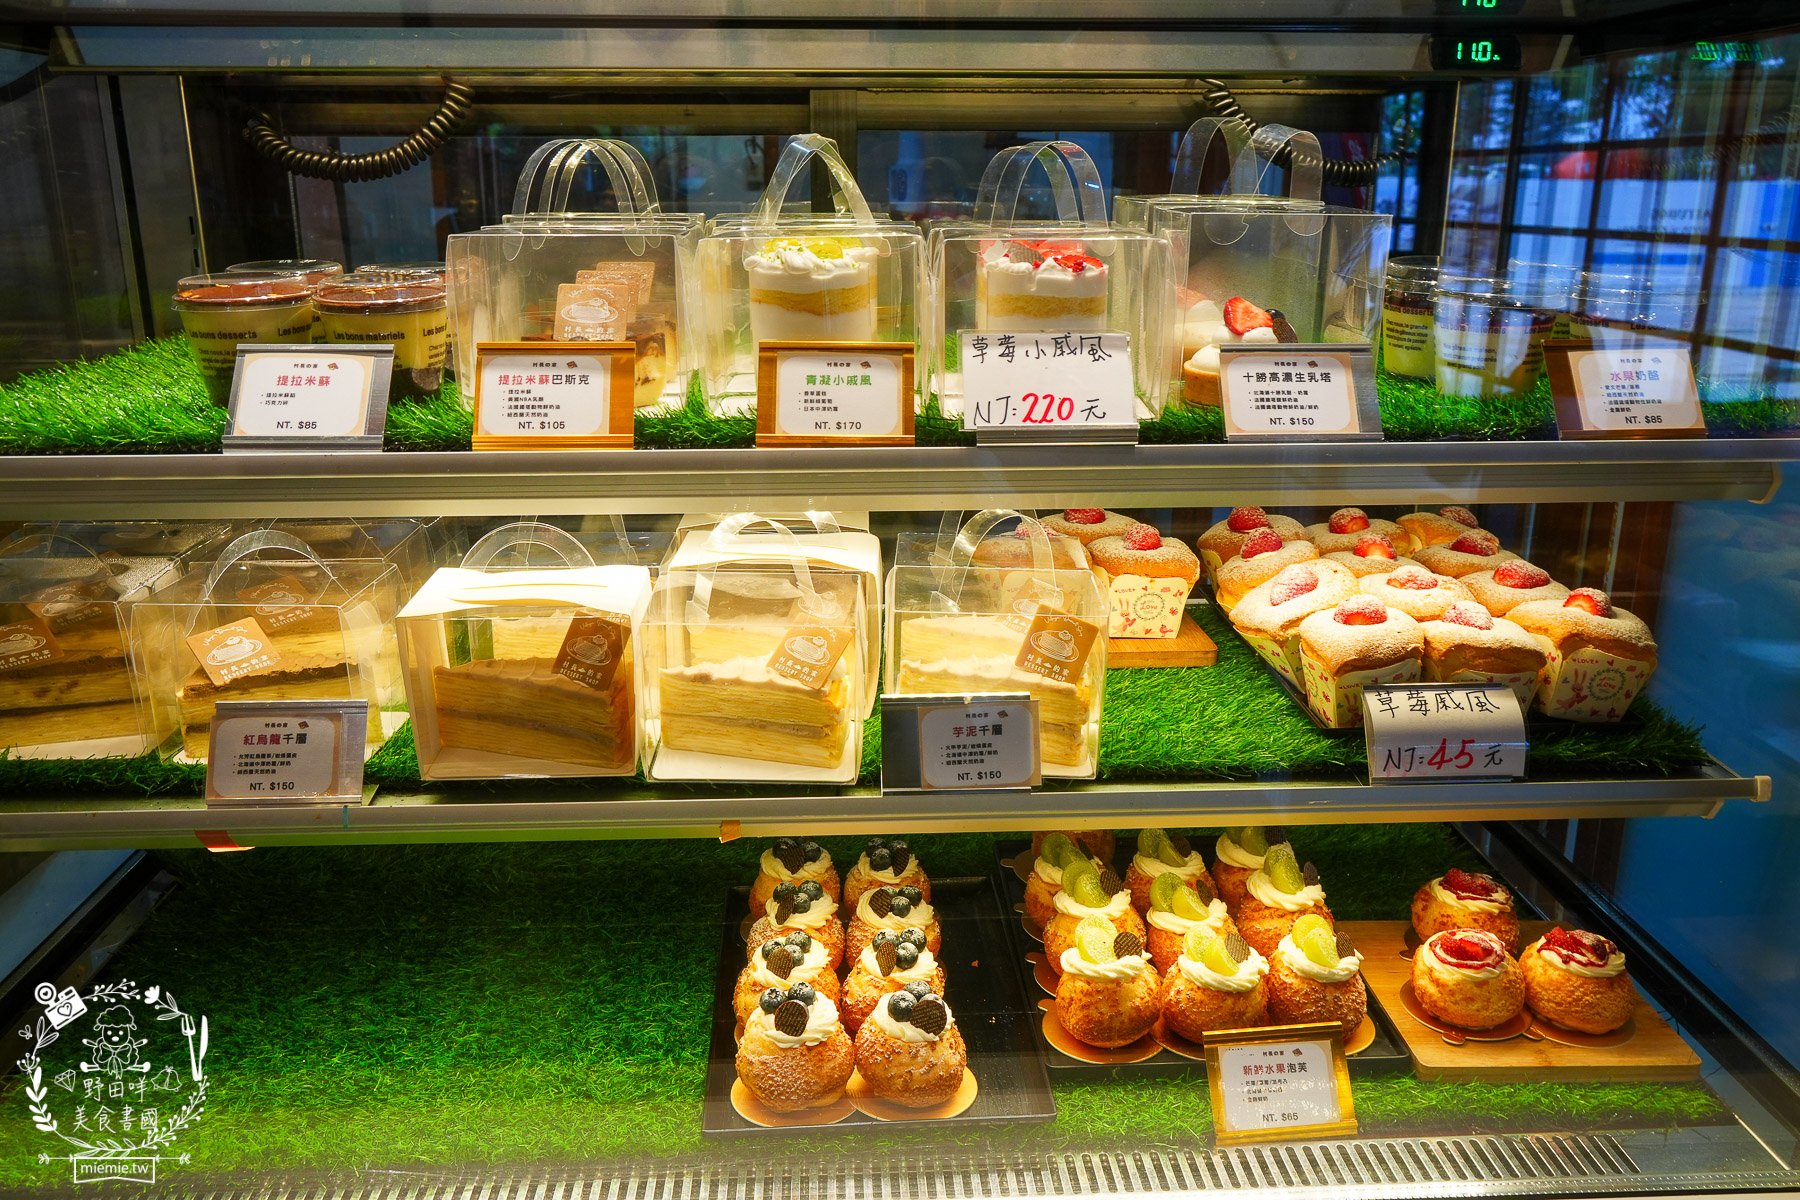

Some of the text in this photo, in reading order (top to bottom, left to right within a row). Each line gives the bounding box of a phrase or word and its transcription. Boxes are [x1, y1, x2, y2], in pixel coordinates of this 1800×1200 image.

[1402, 308, 1434, 316] desserts
[199, 331, 216, 339] bons
[217, 331, 257, 339] desserts
[278, 327, 292, 336] Les
[346, 332, 364, 341] bons
[366, 331, 406, 341] materiels
[423, 328, 434, 337] Les
[277, 376, 331, 386] 提拉米蘇
[498, 374, 590, 386] 提拉米蘇巴斯克
[806, 374, 872, 386] 青凝小戚風
[1243, 372, 1332, 383] 十勝高濃生乳塔
[1610, 370, 1660, 382] 水果奶酪
[1270, 417, 1315, 426] NT. $150
[1625, 415, 1663, 424] NT. $85
[276, 420, 318, 430] NT. $85
[518, 420, 566, 430] NT. $105
[814, 421, 862, 430] NT. $170
[1024, 660, 1066, 682] DESSERT SHOP
[952, 724, 1003, 738] 芋泥千層
[243, 733, 308, 746] 紅烏龍千層
[958, 770, 1002, 781] NT. $150
[250, 782, 295, 791] NT. $150
[1242, 1062, 1308, 1076] 新鮮水果泡芙
[1262, 1112, 1299, 1122] NT. $65
